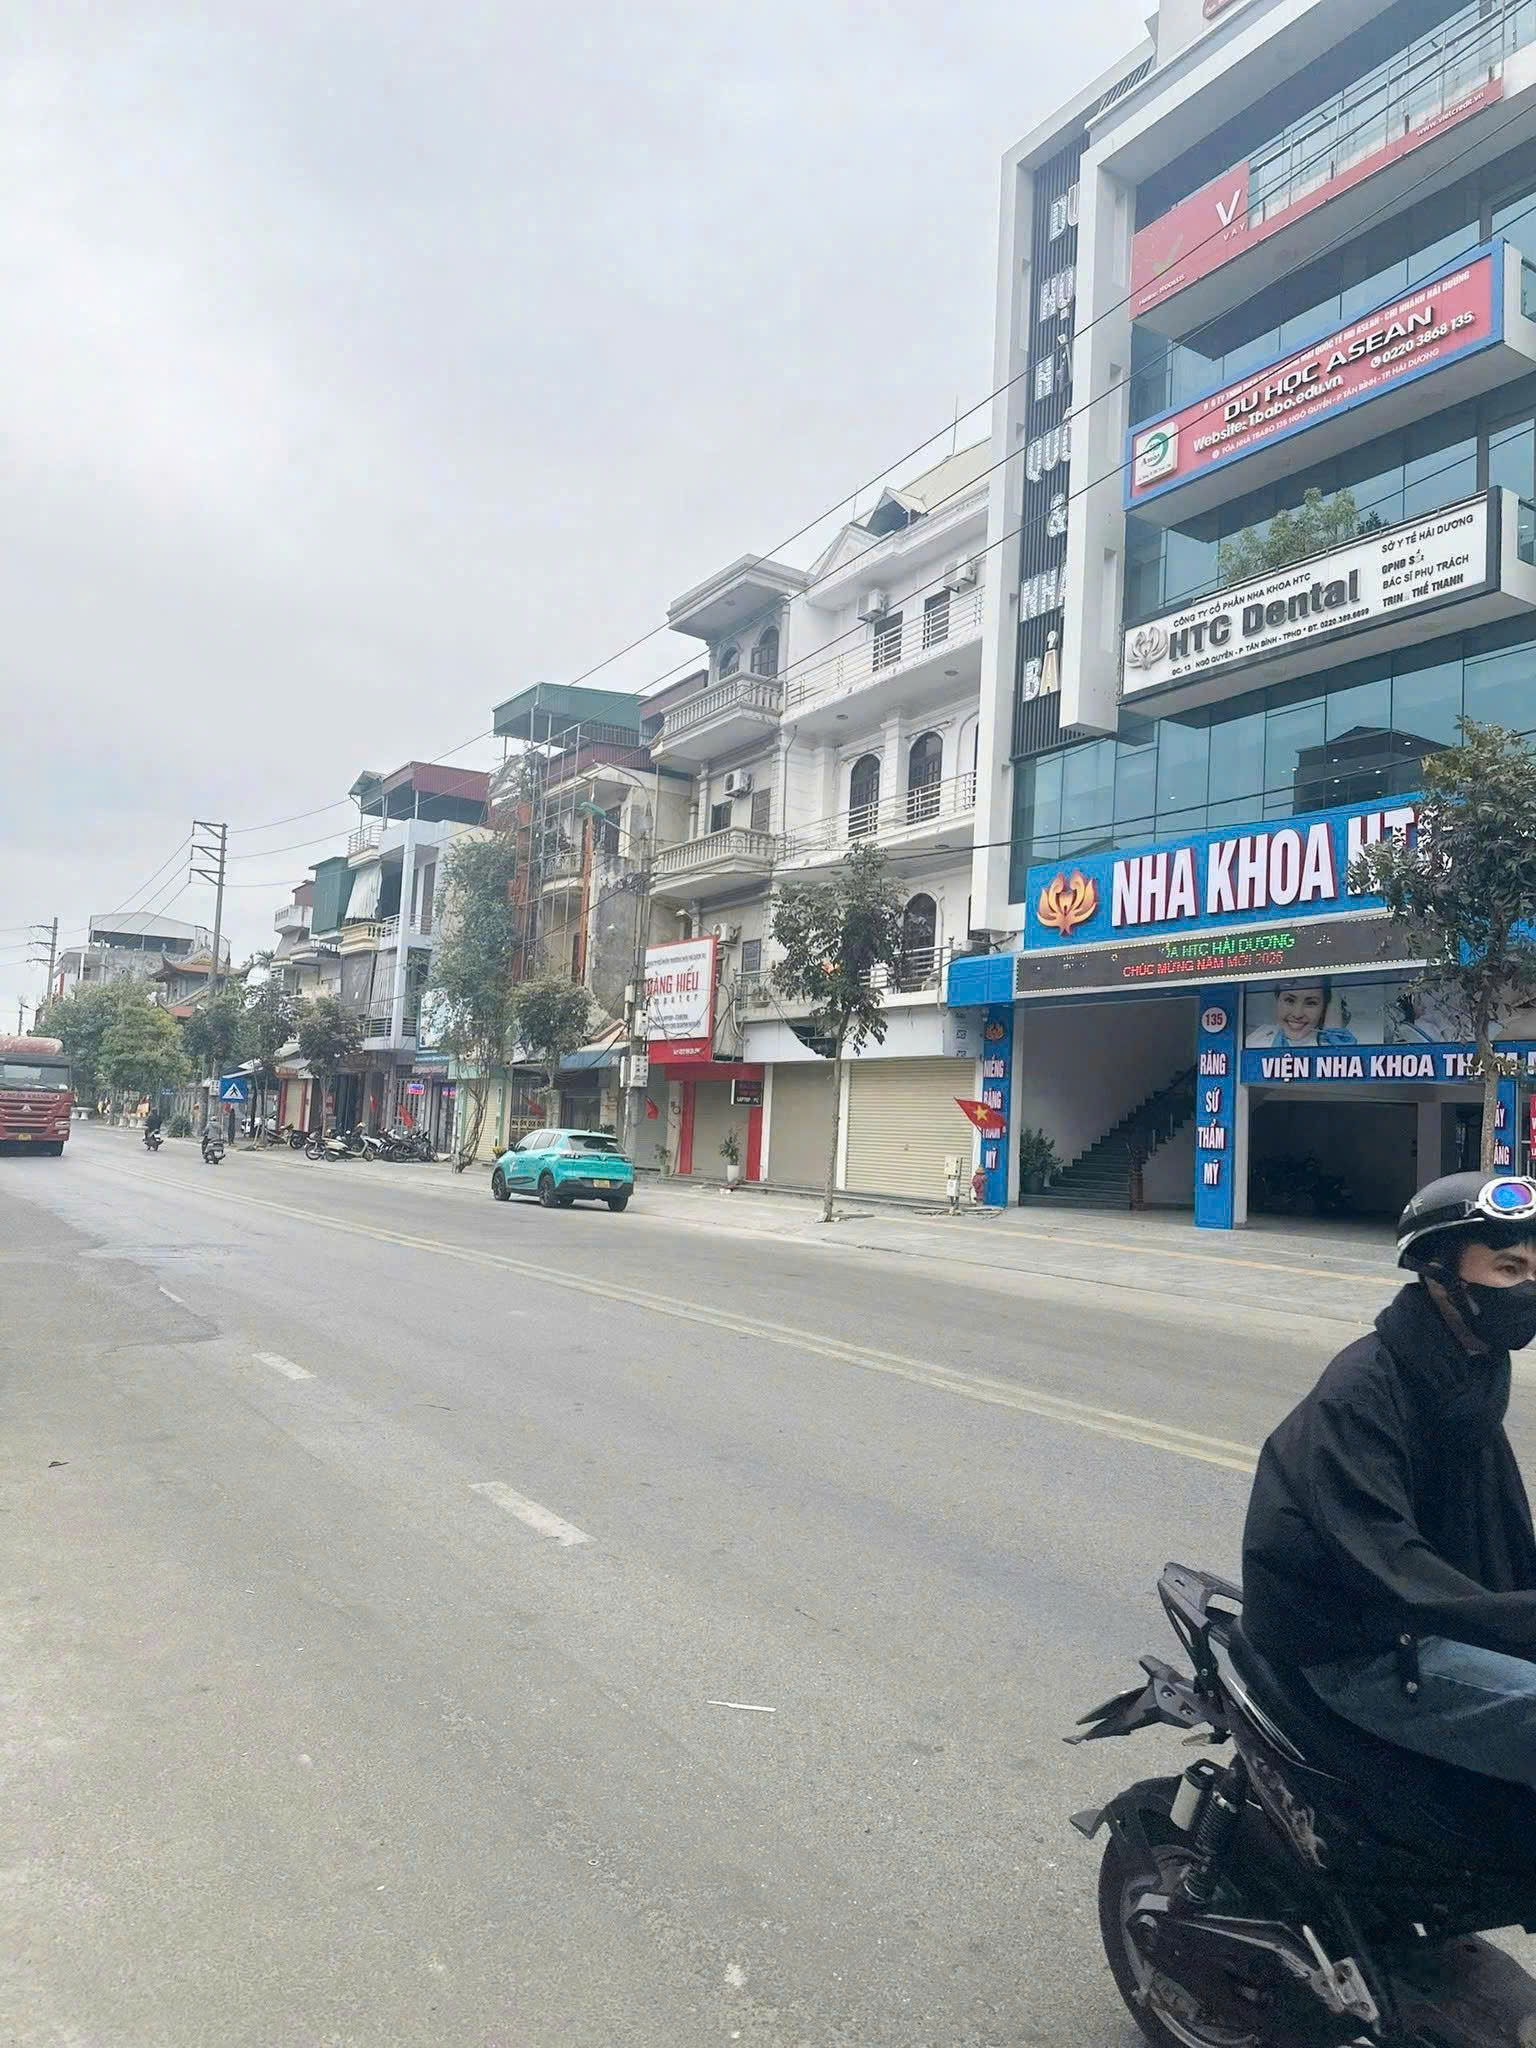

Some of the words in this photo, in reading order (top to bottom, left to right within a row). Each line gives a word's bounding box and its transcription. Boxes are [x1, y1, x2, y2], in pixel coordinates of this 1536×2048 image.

[1050, 181, 1080, 242] DU
[1040, 264, 1075, 323] HỌ
[1223, 390, 1260, 422] DU
[1264, 362, 1320, 402] HỌC
[1326, 305, 1433, 374] ASEAN
[1193, 421, 1249, 453] Website:
[1247, 374, 1344, 427] Tbabo.edu.vn
[1382, 339, 1414, 363] 0220
[1415, 322, 1448, 347] 3868
[1451, 310, 1474, 330] 135
[1381, 540, 1396, 553] SỞ
[1397, 538, 1404, 548] Y
[1405, 531, 1417, 546] TẾ
[1419, 526, 1435, 541] HẢI
[1437, 514, 1473, 535] DƯƠNG
[1382, 576, 1402, 590] BÁC
[1414, 565, 1434, 580] PHỤ
[1436, 554, 1469, 573] TRÁCH
[1411, 580, 1429, 598] THẾ
[1431, 573, 1464, 592] THANH
[1168, 614, 1231, 661] HTC
[1242, 568, 1361, 638] Dental
[1173, 613, 1196, 628] CÔNG
[1198, 609, 1208, 619] TY
[1209, 602, 1221, 615] CỔ
[1222, 595, 1245, 611] PHẦN
[1247, 589, 1265, 601] NHA
[1266, 580, 1291, 595] KHOA
[1293, 572, 1311, 587] HTC
[1023, 630, 1061, 703] BẢ
[1195, 657, 1210, 669] NGÔ
[1211, 649, 1235, 664] QUYỀN
[1245, 641, 1260, 652] TÂN
[1260, 636, 1278, 648] BÌNH
[1112, 847, 1198, 928] NHA
[1207, 822, 1338, 915] KHOA
[1212, 936, 1235, 956] HẢI
[1238, 933, 1295, 953] DƯƠNG
[676, 964, 700, 993] HIẾU
[1122, 962, 1155, 977] CHÚC
[1157, 959, 1194, 974] MỪNG
[1196, 955, 1224, 970] NĂM
[1204, 1013, 1224, 1027] 135
[1200, 1049, 1227, 1076] RĂNG
[1261, 1053, 1311, 1083] VIỆN
[1316, 1055, 1365, 1079] NHA
[1370, 1054, 1436, 1078] KHOA
[1205, 1086, 1221, 1114] SỨ
[1198, 1118, 1225, 1150] THẨM
[985, 1147, 997, 1170] MỸ
[1203, 1159, 1219, 1186] MỸ
